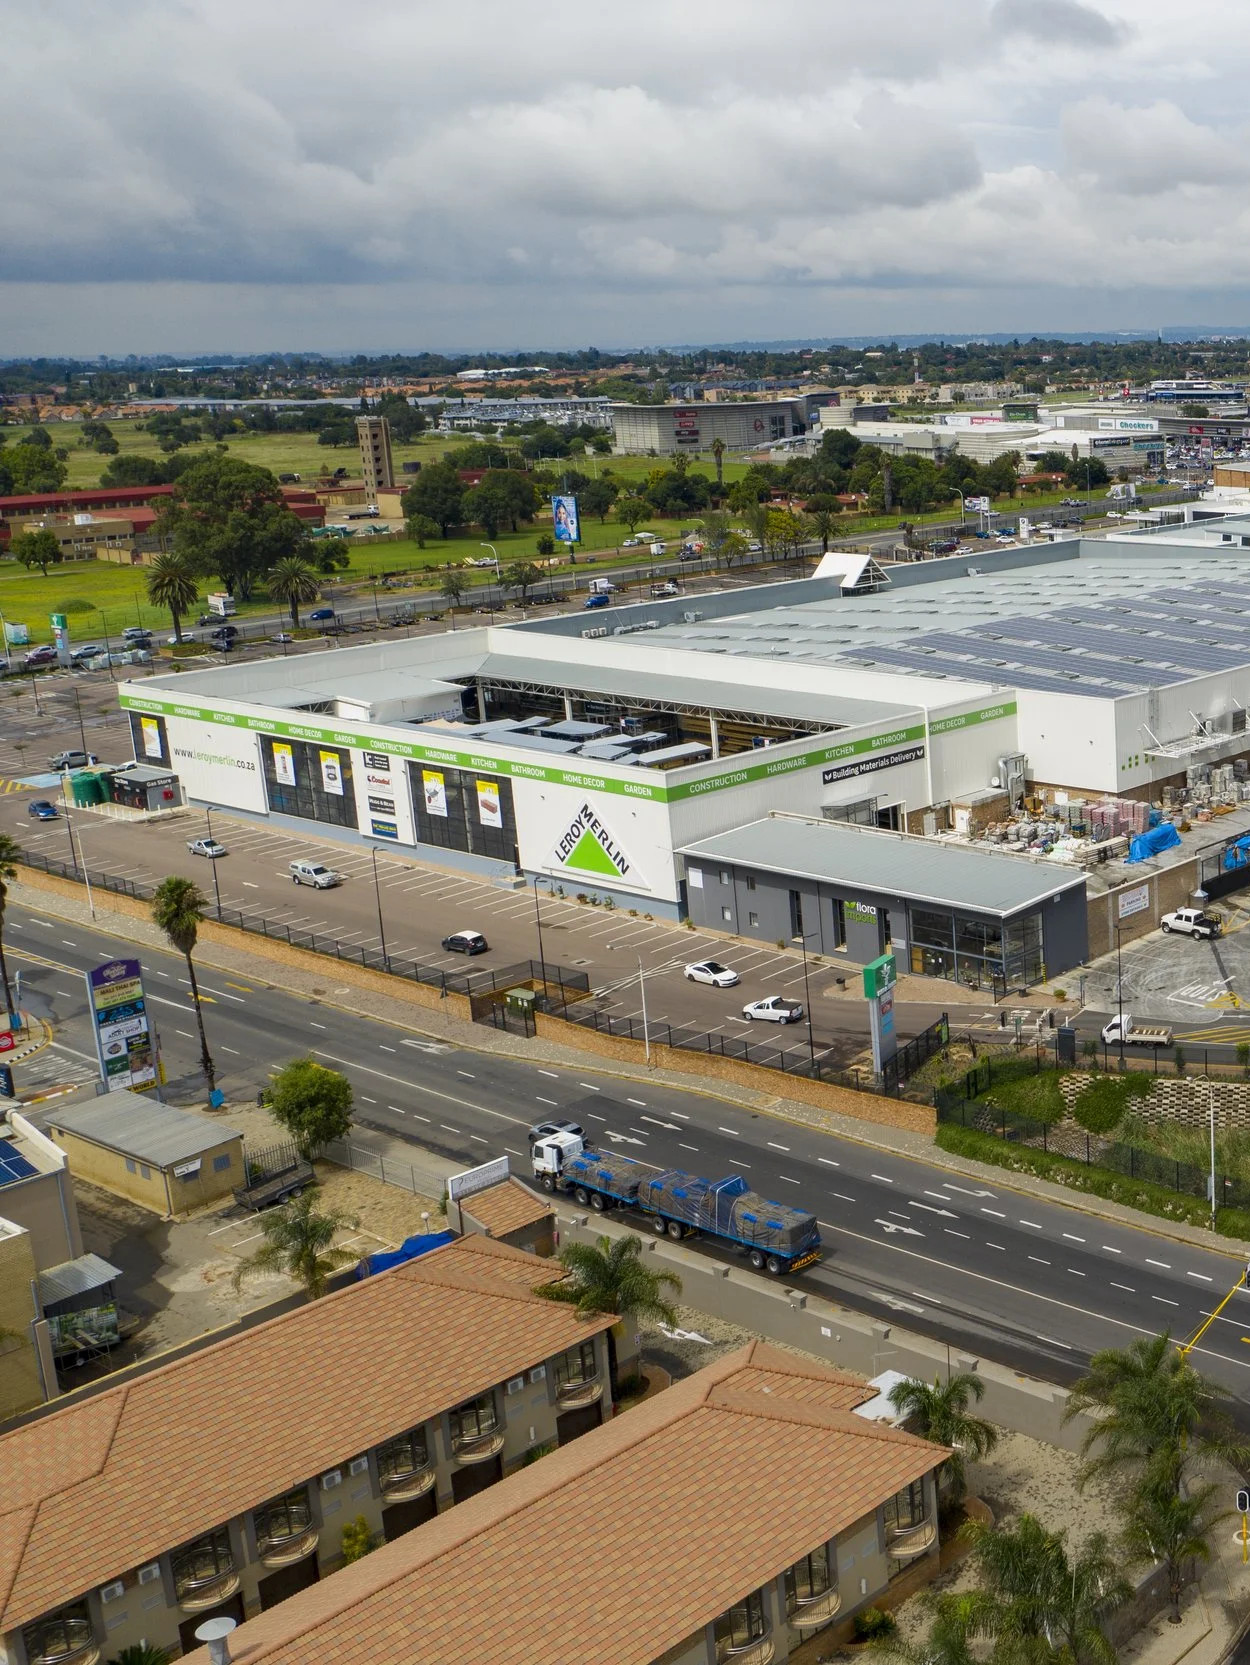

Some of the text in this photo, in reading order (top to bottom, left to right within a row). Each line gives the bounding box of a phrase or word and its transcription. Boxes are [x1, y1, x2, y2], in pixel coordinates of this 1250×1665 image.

[1119, 421, 1153, 430] Checkers
[128, 698, 652, 798] CONSTRUCTION HARDWARE KITCHEN BATHROOM HOME DECOR GARDEN CONSTRUCTION HARDWARE KITCHEN BATHROOM HOME DECOR GARDEN
[173, 747, 256, 771] www.leroymerlin.co.za
[689, 771, 748, 794] CONSTRUCTION
[767, 756, 808, 775] HARDWARE
[825, 745, 855, 760] KITCHEN
[871, 731, 907, 748] BATHROOM
[946, 717, 966, 729] DECOR
[980, 706, 1004, 720] GARDEN
[832, 750, 916, 779] Building Materials Delivery
[554, 813, 586, 862] LEROY
[580, 803, 630, 875] MERLIN
[856, 901, 876, 915] flora
[132, 1080, 155, 1091] WORLD
